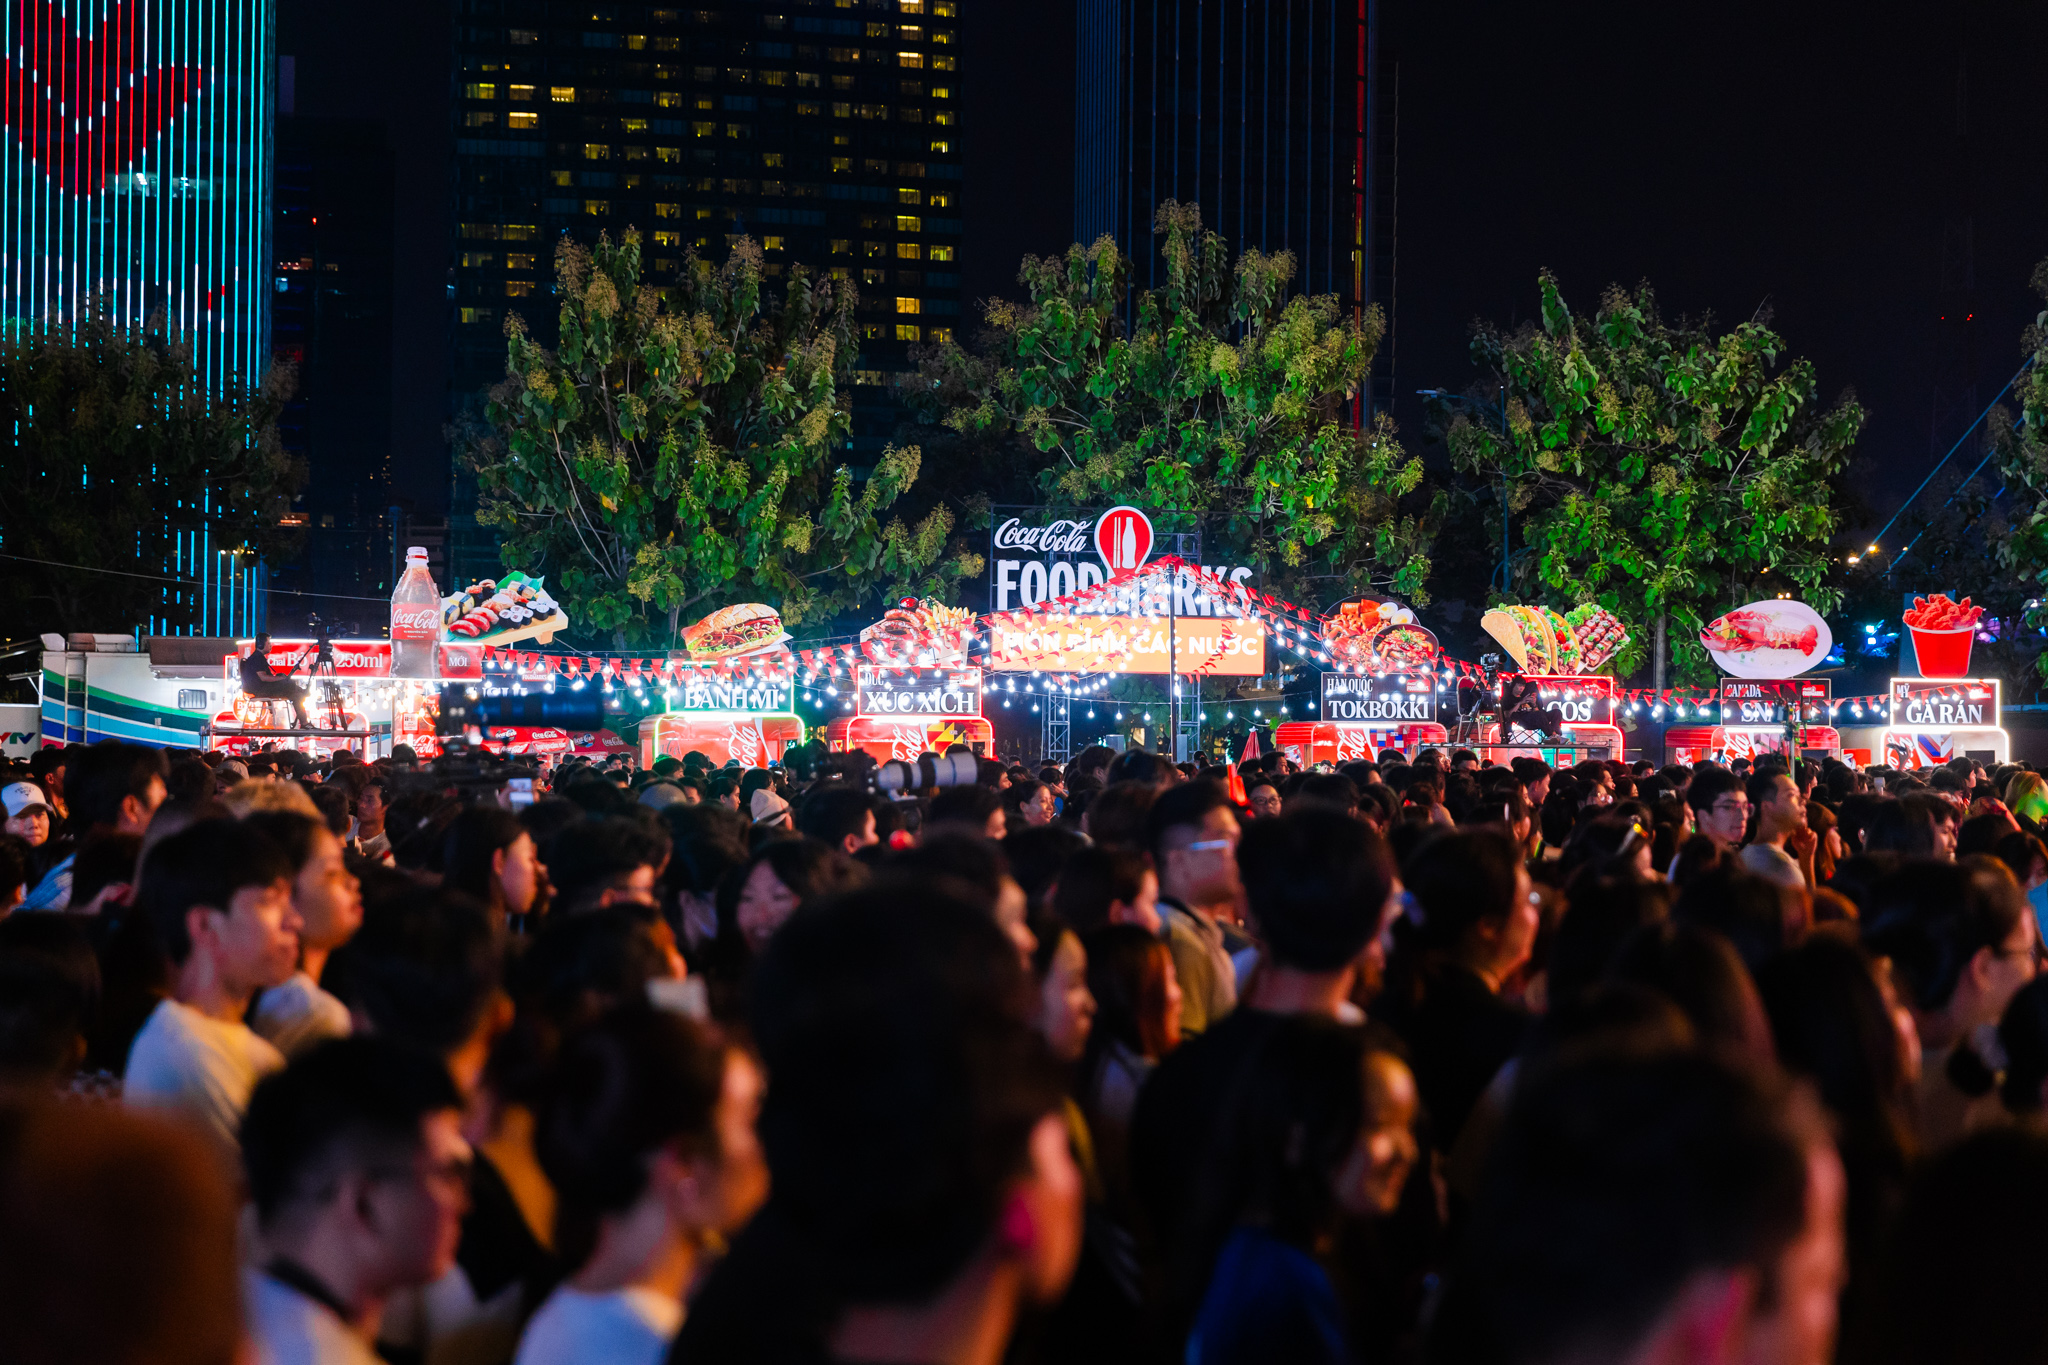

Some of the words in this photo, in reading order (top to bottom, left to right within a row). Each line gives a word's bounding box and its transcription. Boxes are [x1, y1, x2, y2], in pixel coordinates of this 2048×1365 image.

[994, 517, 1093, 553] Coca-Cola
[392, 608, 440, 629] Coca-Cola
[1133, 631, 1182, 653] CÁC
[336, 652, 383, 668] 250ml
[448, 655, 468, 667] MỚI
[1327, 676, 1347, 692] HÀN
[1350, 675, 1373, 693] QUỐC
[1896, 683, 1910, 698] MỸ
[684, 683, 749, 709] BÁNH
[751, 684, 779, 710] MÌ
[865, 687, 914, 713] XÚC
[1328, 700, 1429, 719] TOKBOKKI
[1906, 700, 1937, 724] GÀ
[1938, 700, 1983, 724] RÁN
